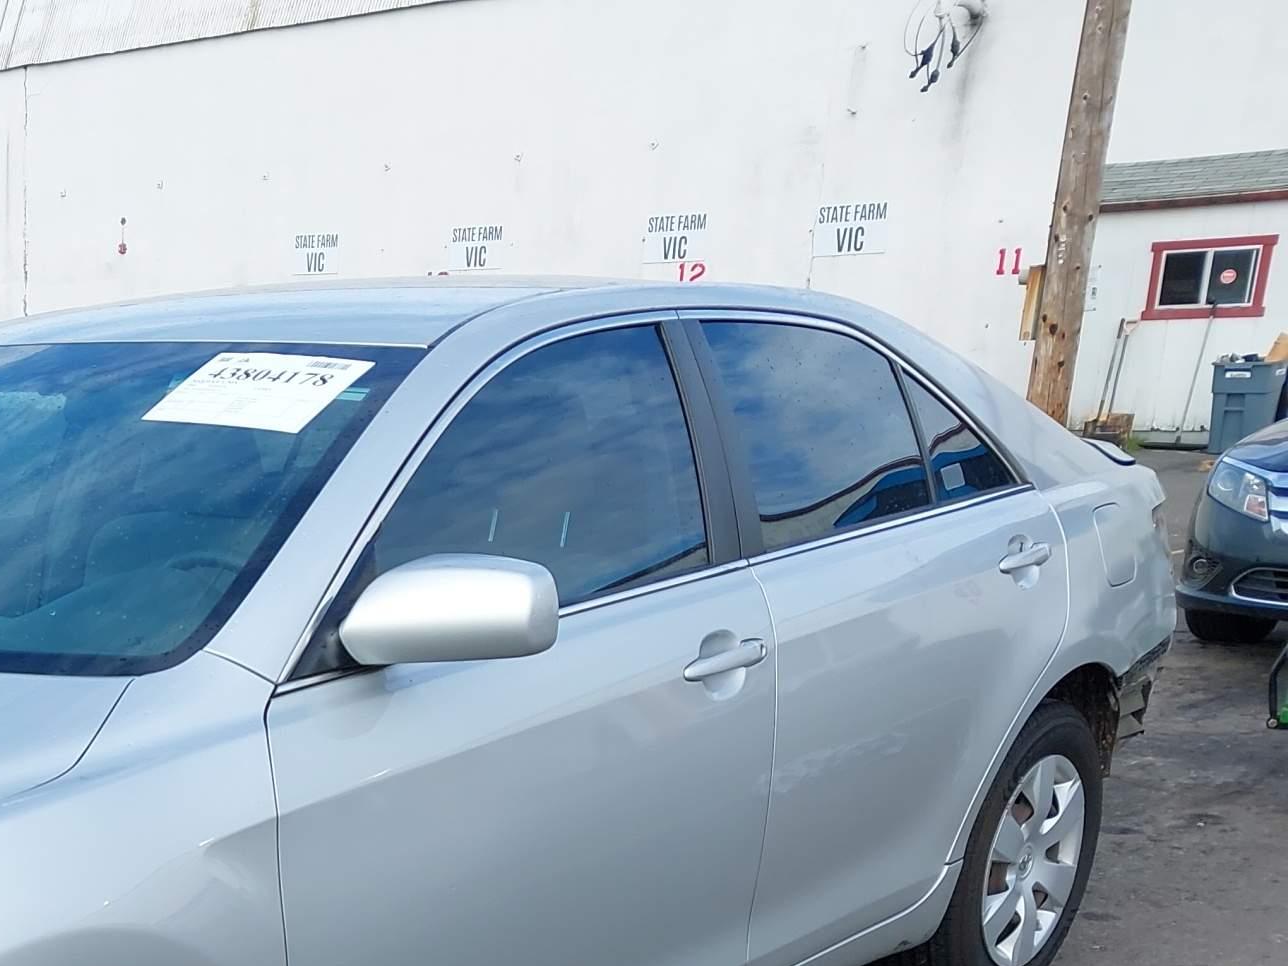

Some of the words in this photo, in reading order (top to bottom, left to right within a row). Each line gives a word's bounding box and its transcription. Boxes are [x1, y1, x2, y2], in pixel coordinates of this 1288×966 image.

[648, 216, 675, 234] STATE
[678, 213, 707, 231] FARM
[818, 205, 850, 224] STATE
[853, 202, 887, 221] FARM
[295, 234, 316, 249] STATE
[317, 233, 339, 248] FARM
[452, 227, 476, 243] STATE
[478, 225, 503, 242] FARM
[835, 226, 865, 253] VIC
[465, 245, 487, 268] VIC
[662, 236, 688, 260] VIC
[306, 252, 325, 273] VIC
[996, 248, 1022, 275] 11
[208, 366, 335, 387] 43804178
